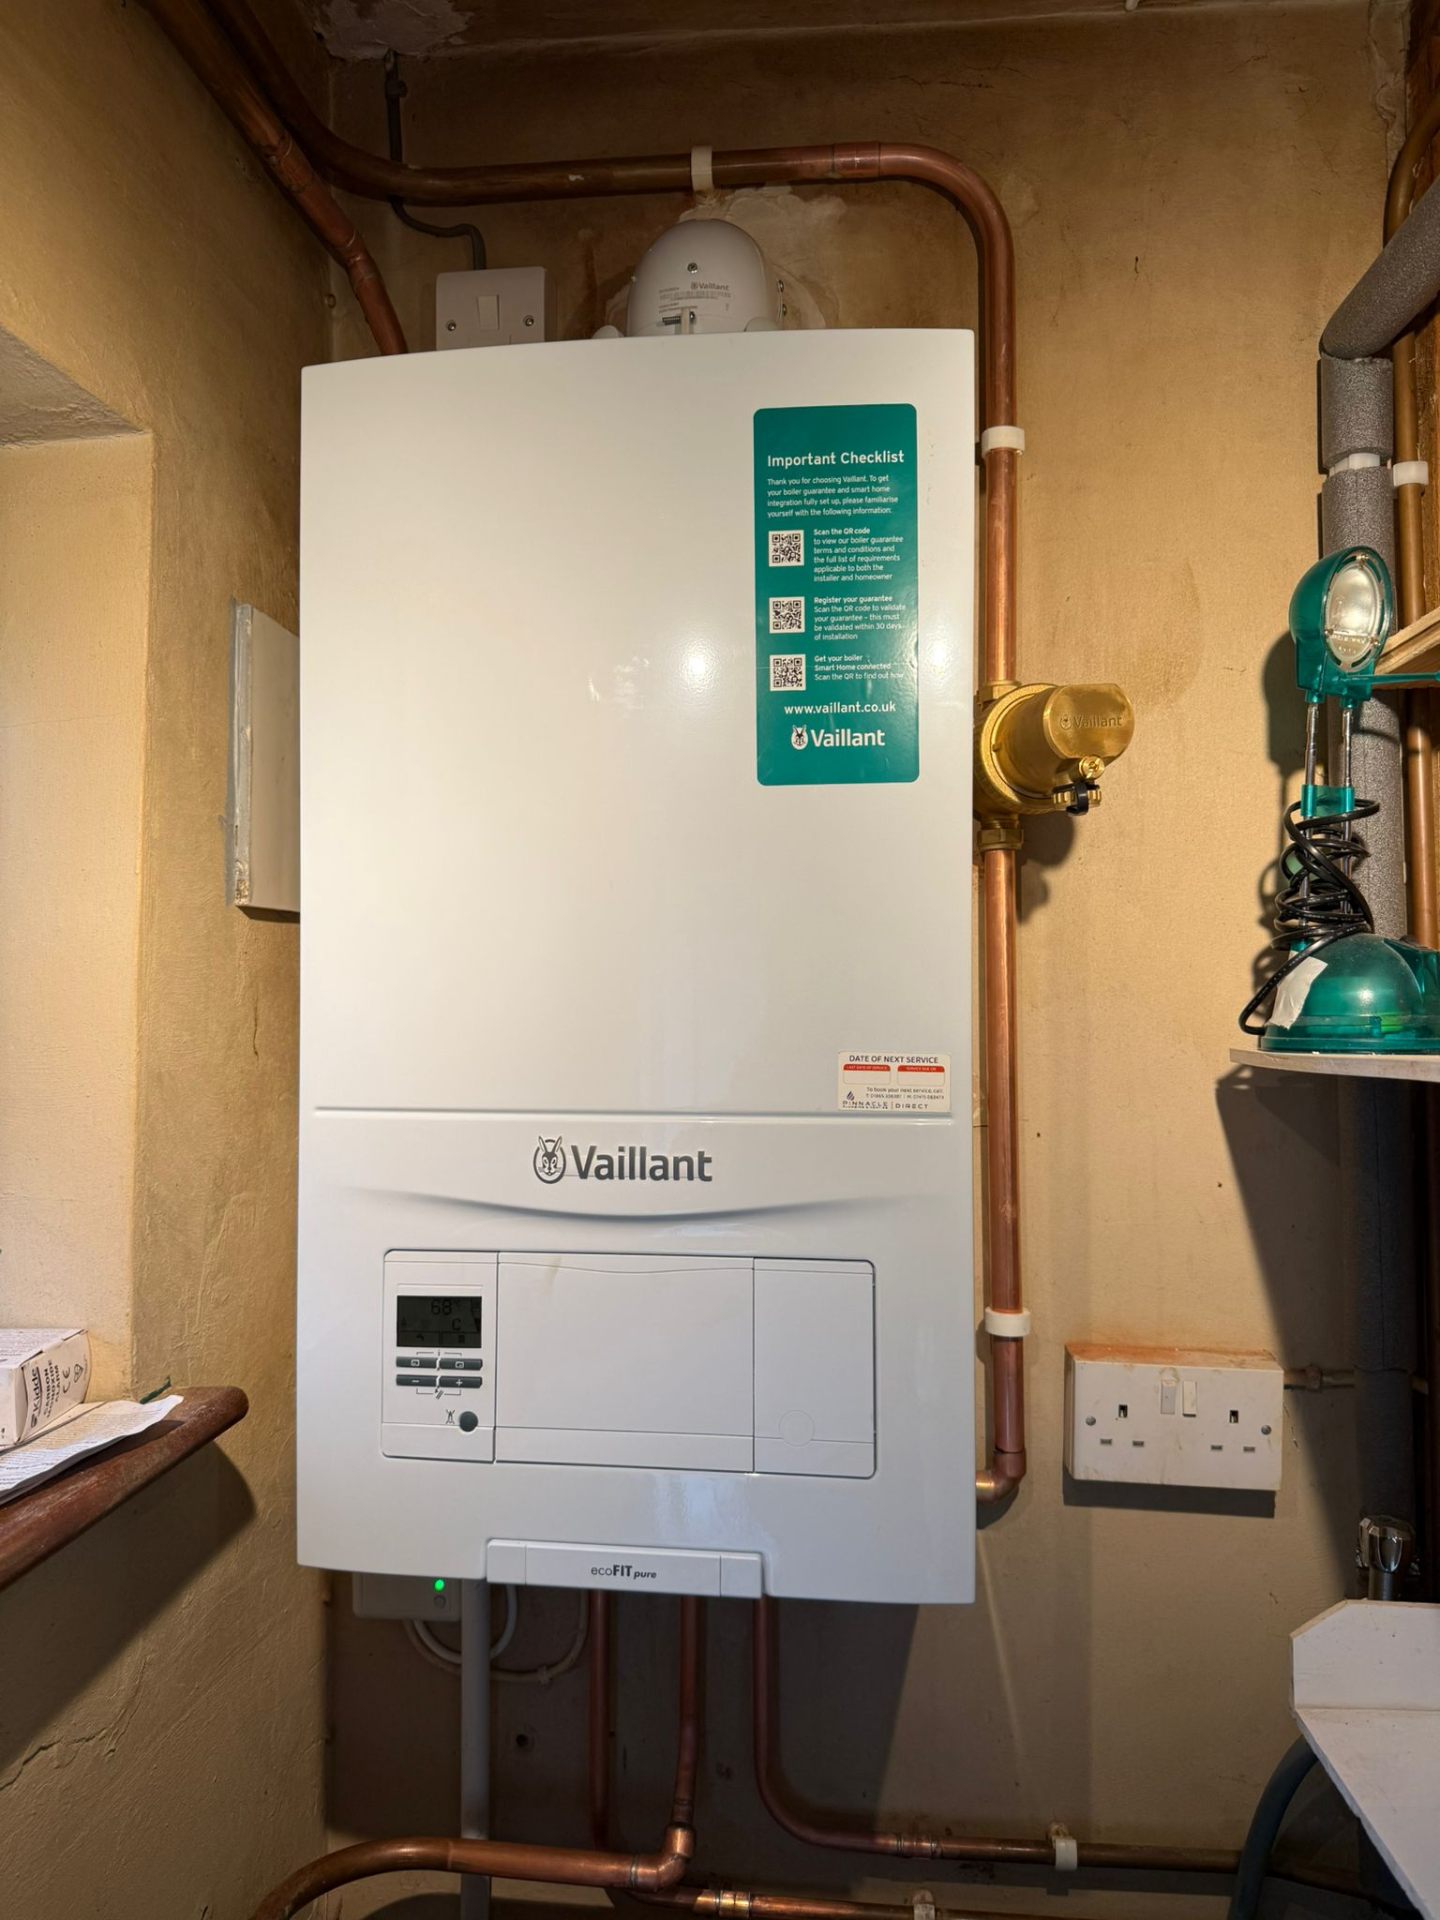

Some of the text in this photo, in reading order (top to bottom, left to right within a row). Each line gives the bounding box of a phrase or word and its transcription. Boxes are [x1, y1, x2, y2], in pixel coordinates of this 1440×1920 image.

[699, 282, 729, 291] Vaillant
[767, 449, 905, 469] Important Checklist
[767, 478, 787, 486] Thank
[788, 478, 801, 486] you
[812, 476, 842, 485] choosing
[842, 475, 868, 483] Vaillant.
[877, 474, 889, 484] get
[767, 489, 782, 497] your
[783, 488, 802, 496] boiler
[802, 487, 836, 496] guarantee
[837, 486, 850, 494] and
[767, 499, 803, 508] integration
[803, 498, 818, 506] fully
[841, 496, 864, 505] please
[767, 509, 793, 518] yourself
[794, 509, 810, 517] with
[810, 508, 822, 516] the
[822, 507, 852, 516] following
[813, 528, 830, 536] Scan
[854, 526, 871, 534] code
[821, 537, 837, 545] view
[850, 536, 869, 544] boiler
[870, 536, 904, 544] guarantee
[833, 546, 847, 554] and
[882, 544, 895, 552] and
[813, 556, 825, 564] the
[826, 555, 837, 563] full
[849, 554, 857, 562] of
[857, 554, 901, 564] requirements
[813, 565, 847, 574] applicable
[854, 573, 893, 581] homeowner
[814, 594, 893, 605] Register your guarantee
[814, 606, 831, 614] Scan
[843, 604, 854, 612] QR
[855, 604, 871, 612] code
[880, 603, 907, 611] validate
[814, 615, 829, 624] your
[829, 614, 863, 623] guarantee
[869, 613, 882, 621] this
[814, 624, 822, 632] be
[823, 624, 854, 632] validated
[854, 623, 875, 631] within
[875, 622, 885, 630] 30
[822, 633, 859, 641] installation
[814, 653, 863, 663] Get your boiler
[814, 662, 892, 672] Smart Home connected
[814, 673, 831, 681] Scan
[831, 673, 843, 681] the
[843, 673, 854, 681] QR
[863, 671, 877, 680] find
[784, 700, 897, 715] www.vaillant.co.uk
[1073, 714, 1123, 729] Vaillant
[811, 728, 886, 748] Vaillant
[849, 1055, 939, 1065] DATE OF NEXT SERVICE
[570, 1144, 713, 1183] Vaillant
[431, 1299, 453, 1316] 68
[31, 1368, 41, 1412] Kidde
[43, 1368, 51, 1416] CARBON
[46, 1360, 56, 1419] MONOXIDE
[590, 1564, 657, 1580] ecoFIT pure
